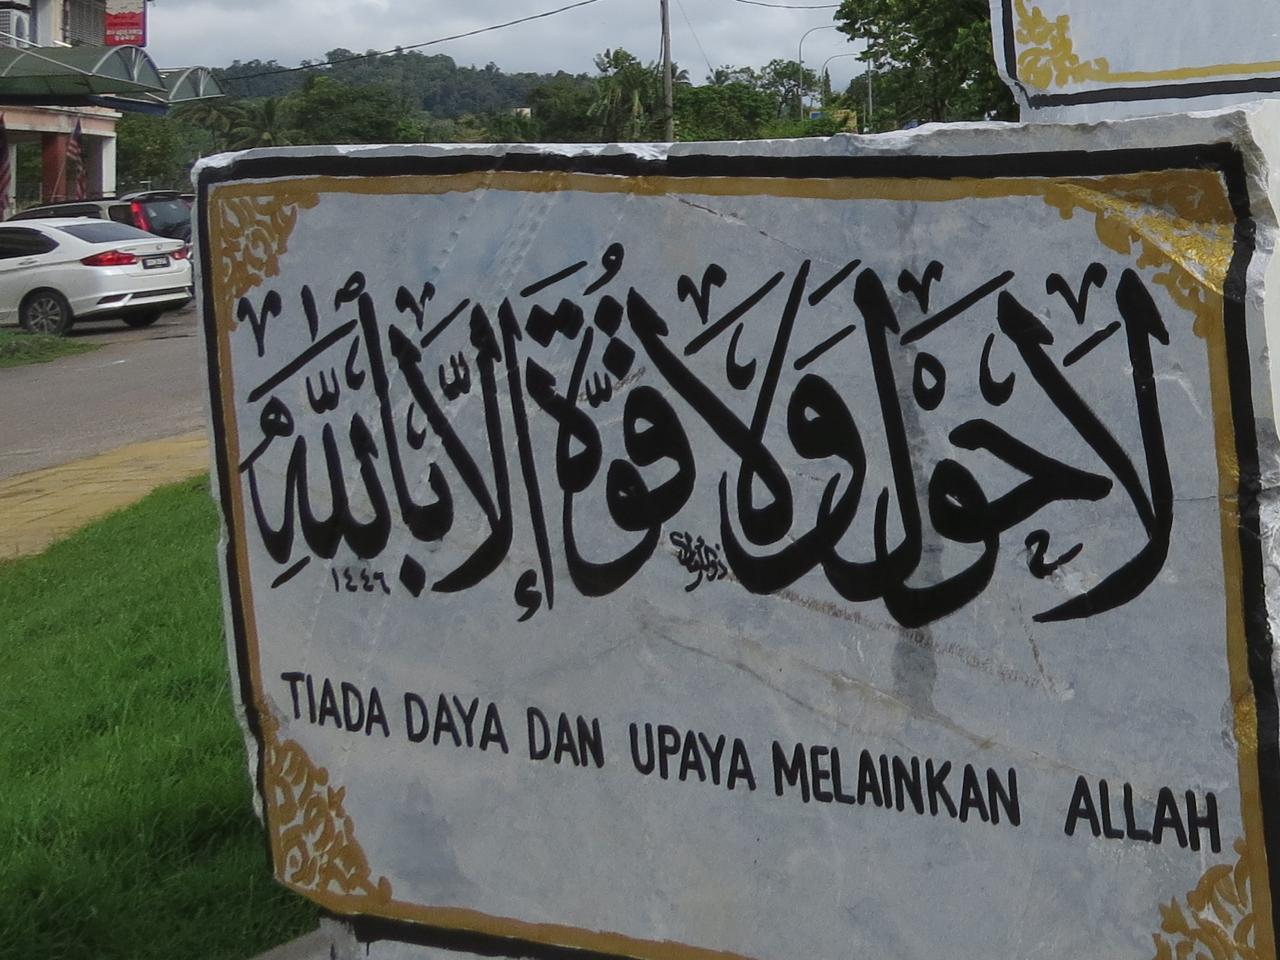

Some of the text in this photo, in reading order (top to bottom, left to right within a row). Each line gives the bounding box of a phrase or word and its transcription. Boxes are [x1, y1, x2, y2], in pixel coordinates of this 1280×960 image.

[281, 672, 1222, 854] TIADA DAYA DAN UPAYA MELAINKAN ALLAH
